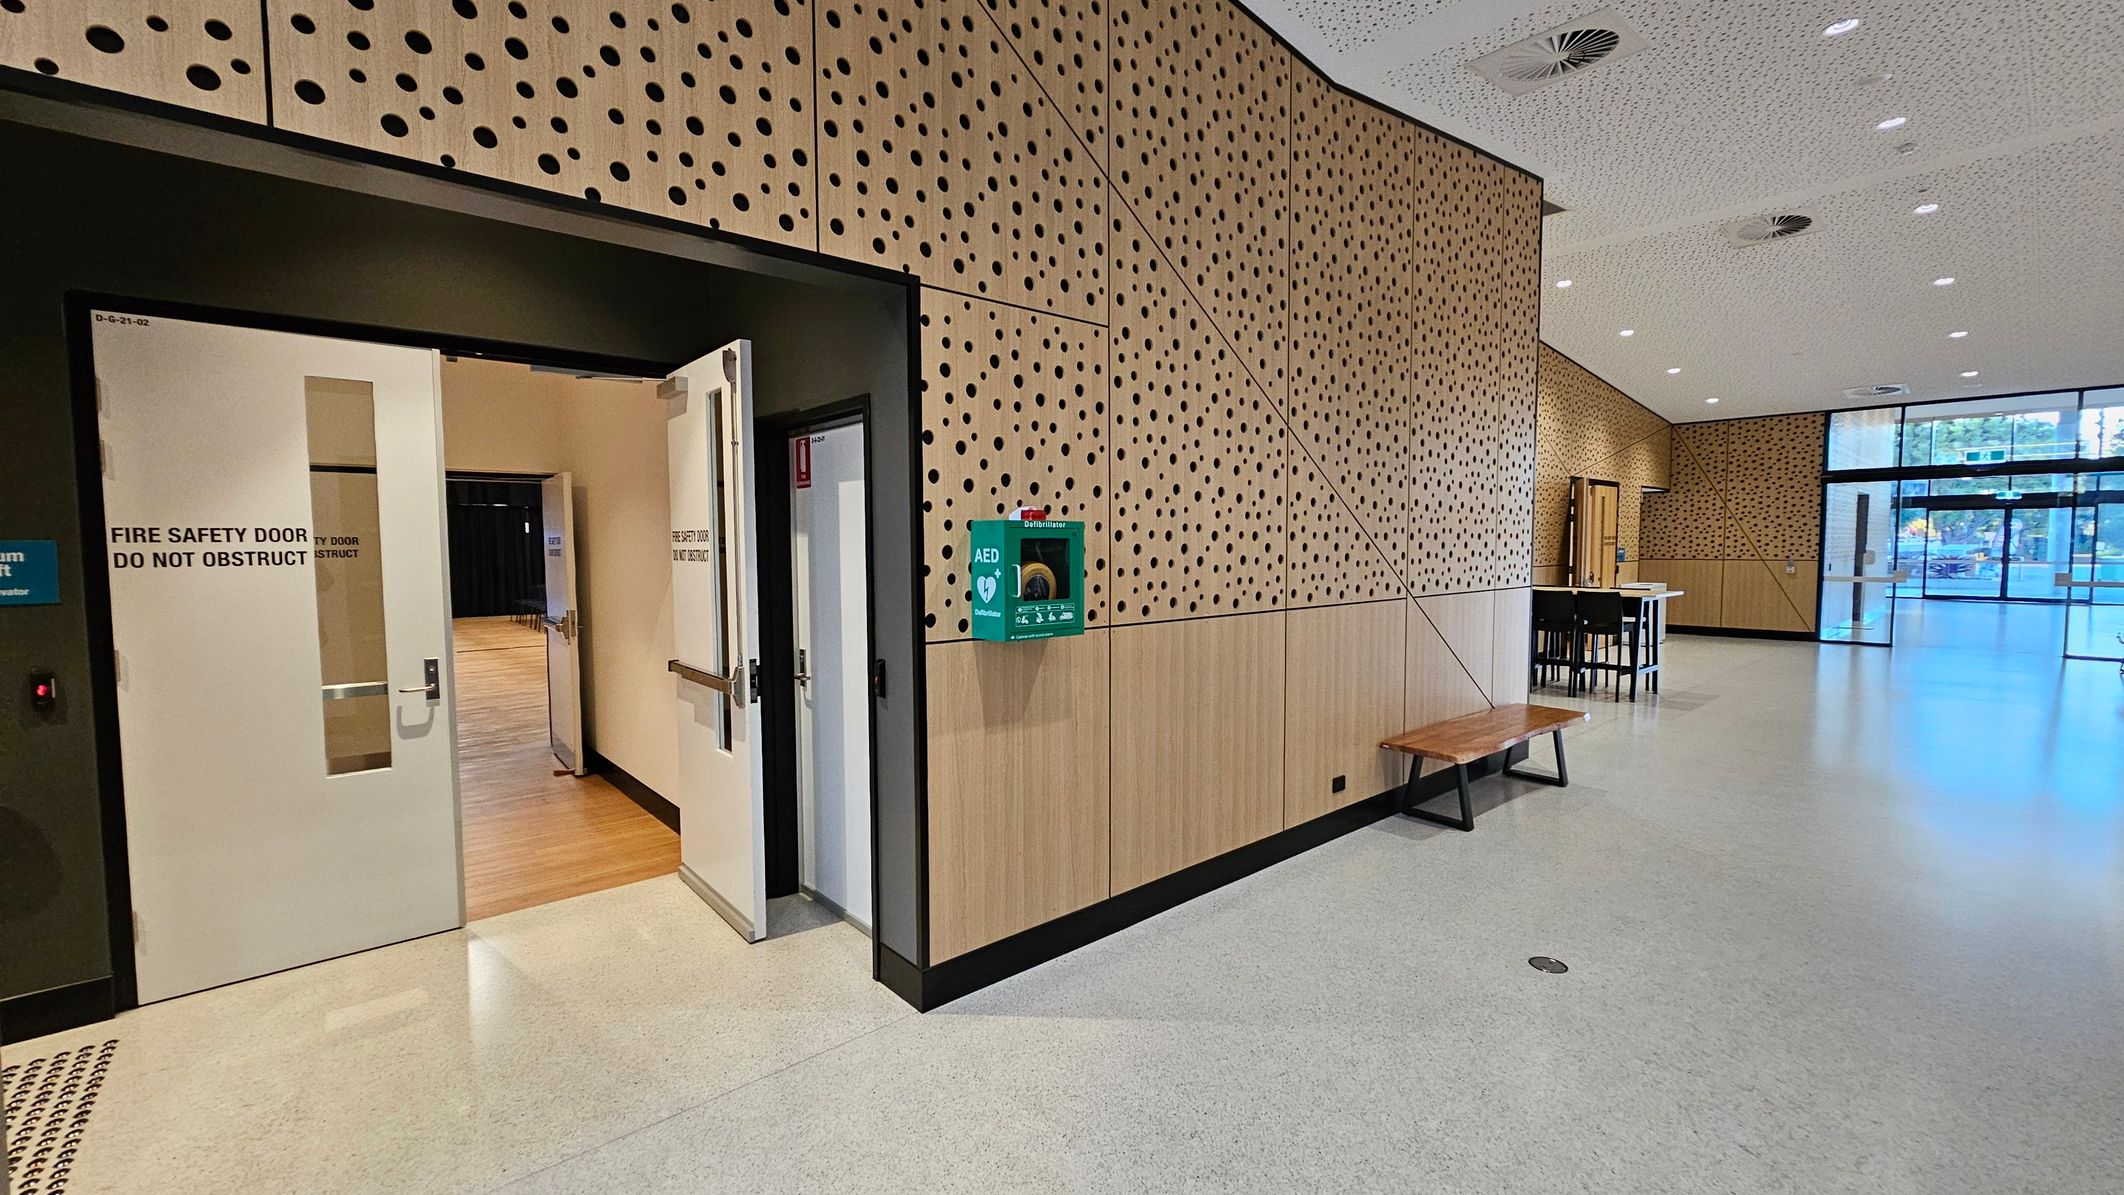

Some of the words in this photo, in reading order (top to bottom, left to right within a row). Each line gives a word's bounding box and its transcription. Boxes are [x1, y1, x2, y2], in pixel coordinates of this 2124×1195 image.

[95, 314, 150, 326] D-G-21-02
[1024, 520, 1066, 529] Defibrillator
[111, 527, 162, 543] FIRE
[168, 527, 247, 543] SAFETY
[254, 527, 308, 543] DOOR
[330, 536, 359, 546] DOOR
[113, 552, 144, 568] DO
[153, 551, 195, 568] NOT
[202, 550, 308, 567] OBSTRUCT
[974, 548, 999, 563] AED
[0, 588, 30, 596] vator
